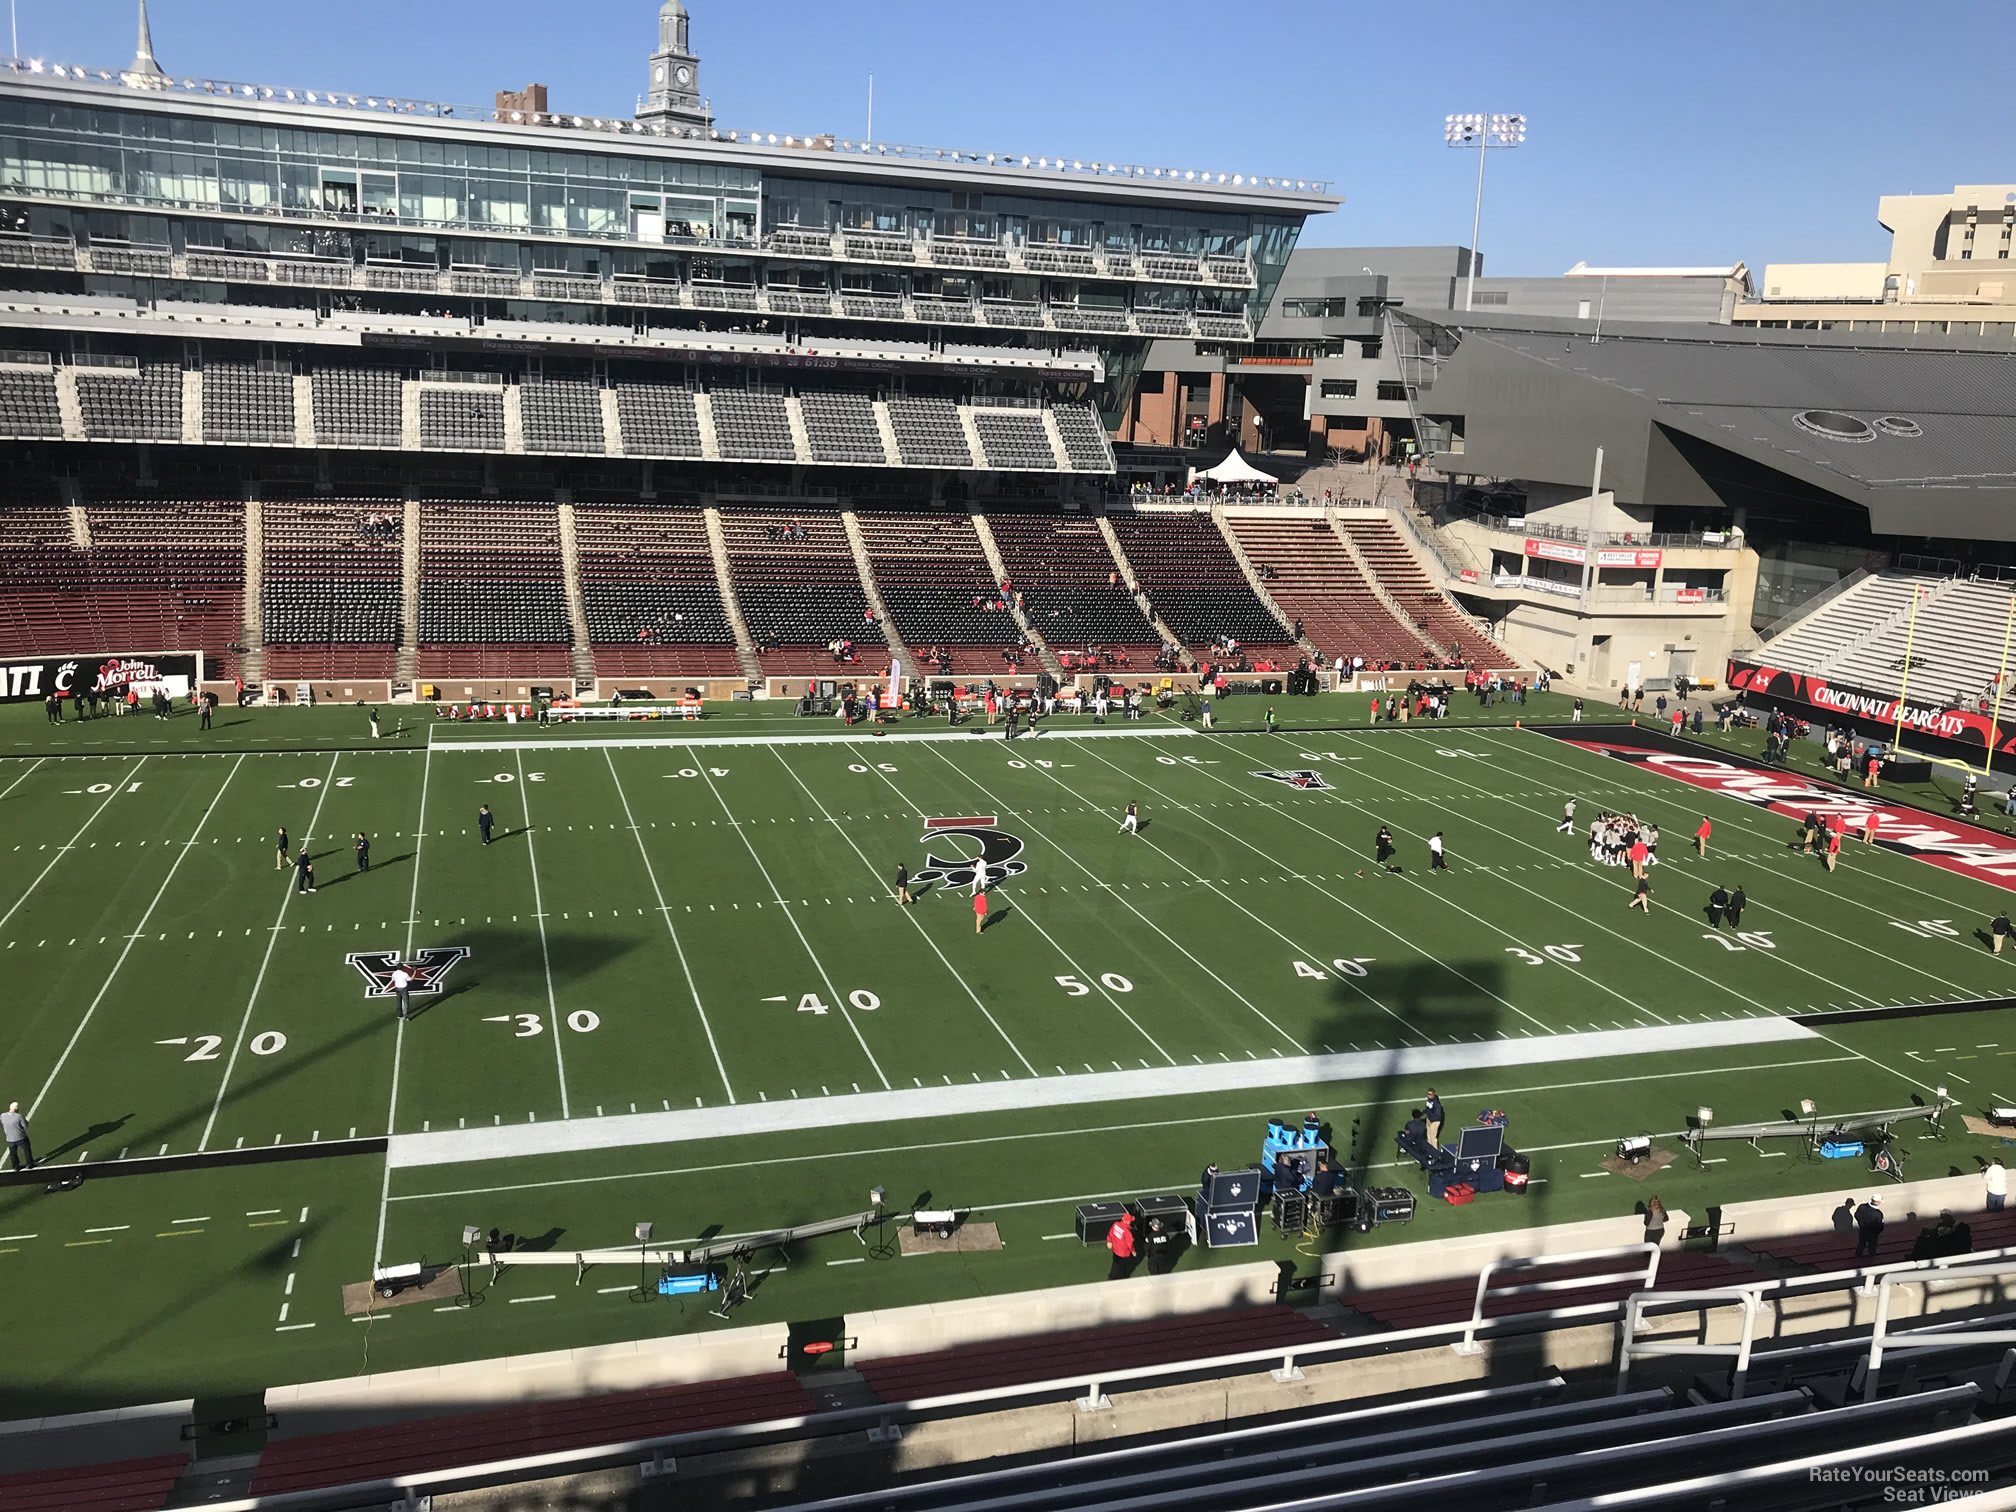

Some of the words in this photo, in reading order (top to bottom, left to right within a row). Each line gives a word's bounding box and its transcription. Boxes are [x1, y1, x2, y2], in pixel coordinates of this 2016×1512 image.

[91, 664, 162, 692] Morrell
[116, 658, 144, 673] John
[1814, 686, 1891, 717] CINCINNATI
[1891, 703, 1965, 735] BEARCATS
